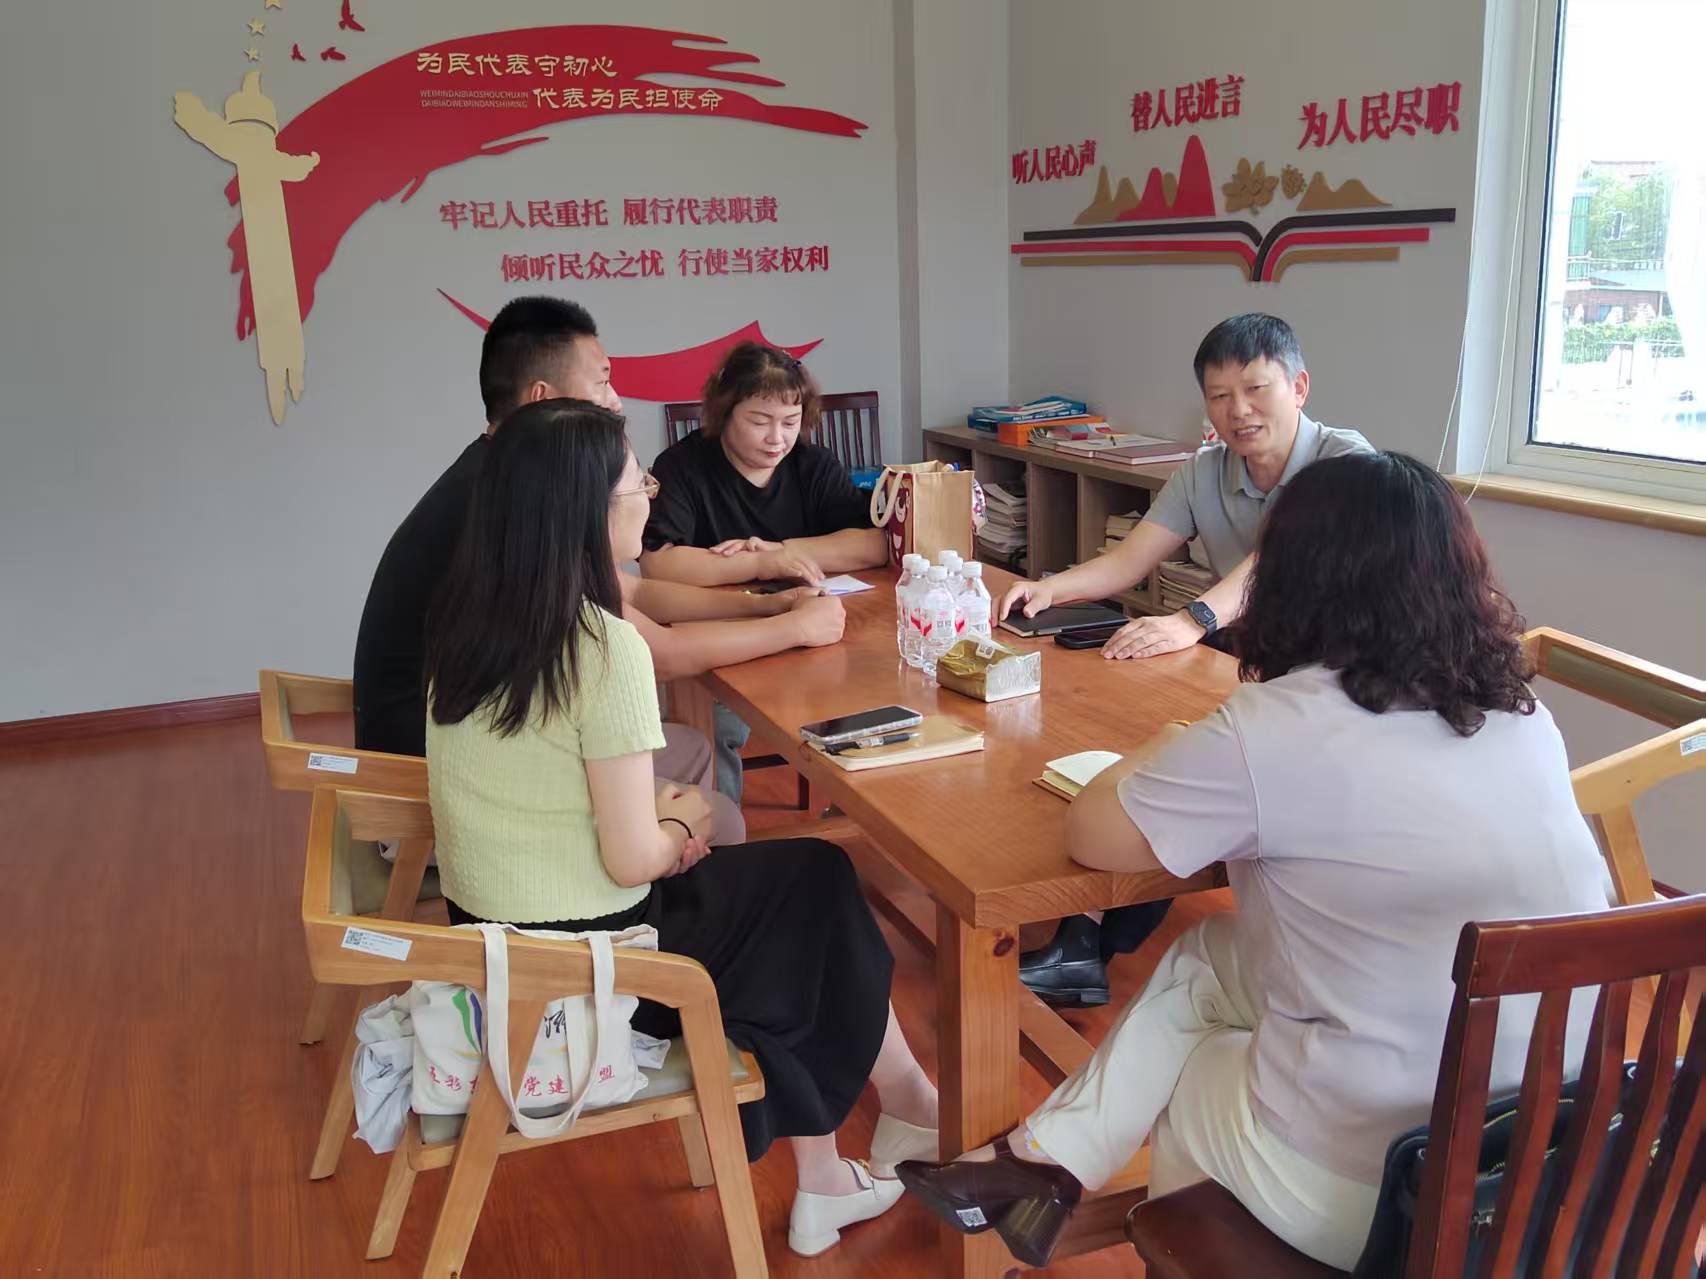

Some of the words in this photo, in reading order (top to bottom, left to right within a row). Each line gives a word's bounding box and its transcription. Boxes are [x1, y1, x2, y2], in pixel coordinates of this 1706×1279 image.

[416, 52, 618, 78] 为民代表守初心
[533, 87, 724, 111] 代表为民担使命
[1131, 74, 1245, 132] 替人民进言
[1297, 81, 1462, 150] 为人民尽职
[1012, 139, 1097, 184] 听人民心声
[440, 199, 608, 230] 牢记人民重托
[624, 197, 778, 226] 履行代表职责
[501, 250, 664, 283] 倾听民众之忧
[678, 245, 830, 276] 行使当家权利
